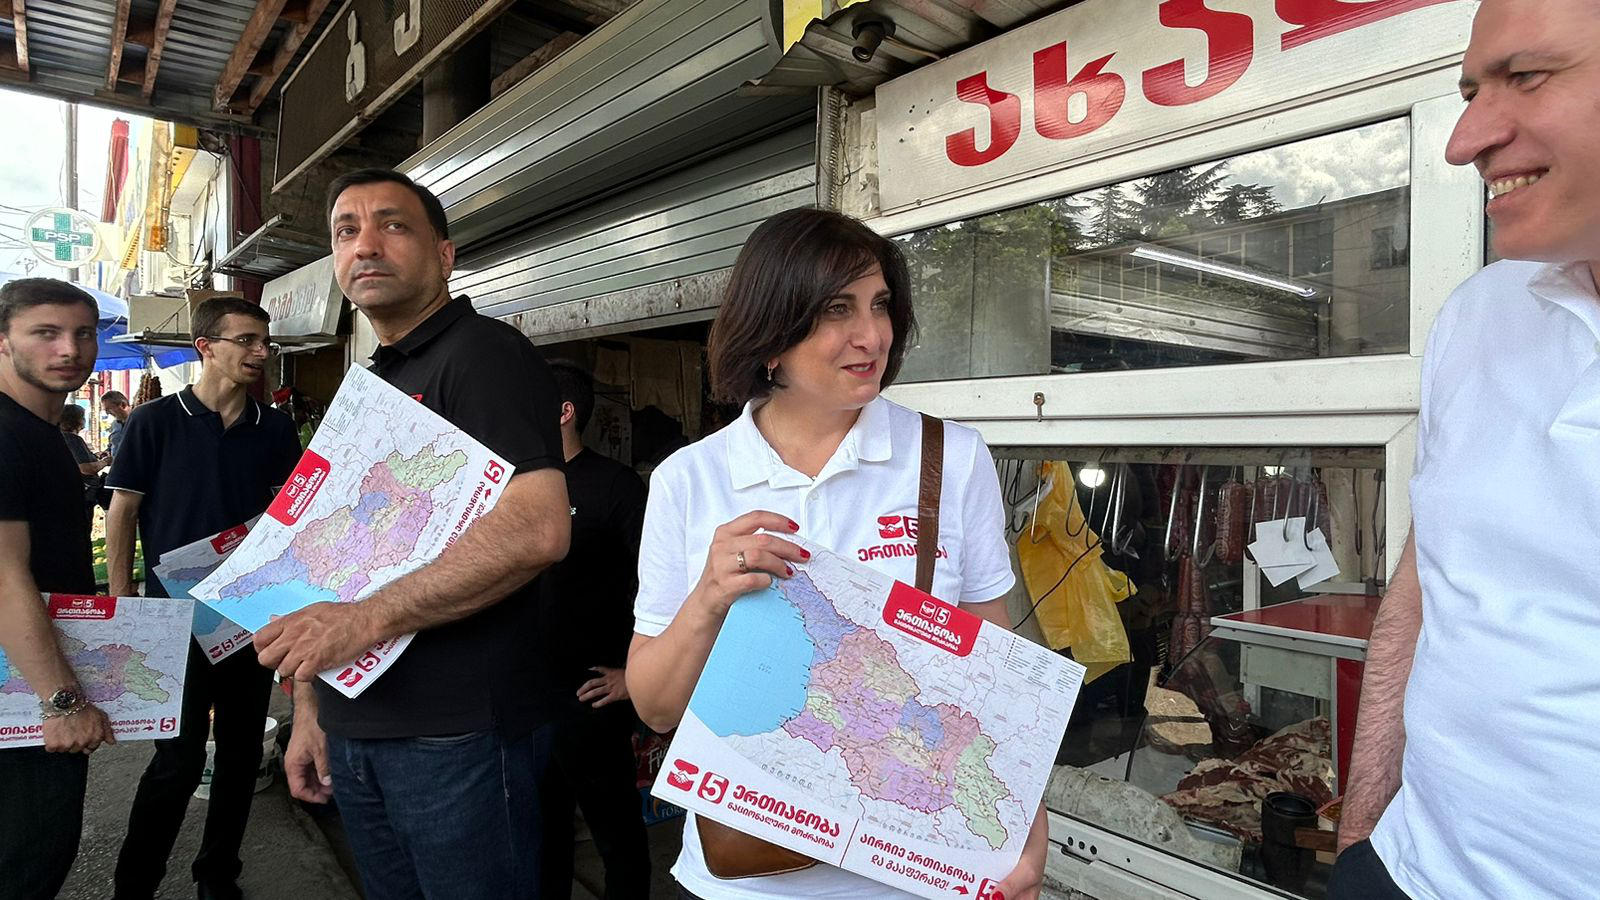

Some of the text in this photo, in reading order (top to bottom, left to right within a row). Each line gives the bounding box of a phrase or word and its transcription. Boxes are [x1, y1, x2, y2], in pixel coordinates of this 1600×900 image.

[45, 231, 81, 243] PSP
[486, 461, 503, 483] 5
[455, 481, 486, 532] ერთიანობა
[896, 608, 962, 646] ერთიანობა
[936, 608, 949, 624] 5
[357, 653, 380, 672] 5
[161, 718, 175, 732] 5
[700, 773, 727, 803] 5
[727, 802, 835, 849] ნაციონალური მოძრაობა
[732, 784, 840, 838] ერთიანობა
[860, 833, 976, 884] აირჩიე ერთიანობა
[871, 854, 884, 867] და
[885, 860, 950, 892] გააფერადე!
